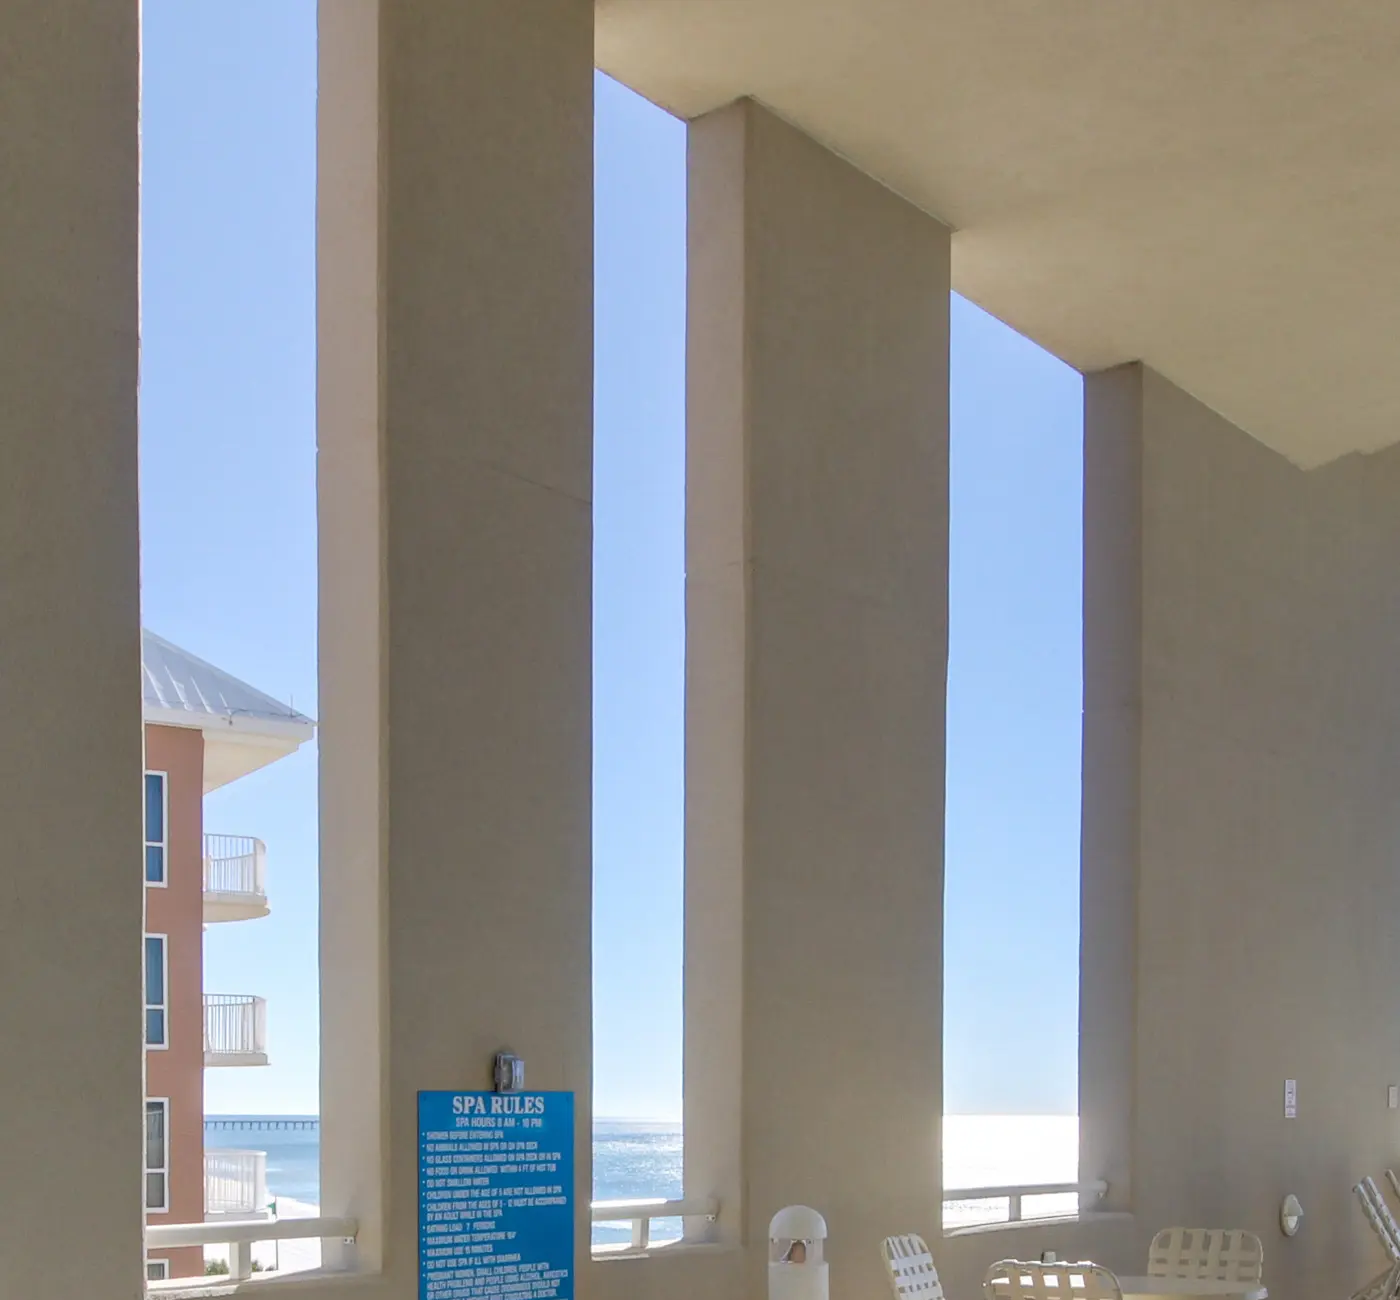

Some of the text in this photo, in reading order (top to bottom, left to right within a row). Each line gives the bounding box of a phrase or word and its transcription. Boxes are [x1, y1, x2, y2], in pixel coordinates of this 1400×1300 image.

[452, 1095, 544, 1114] SPA RULES
[455, 1117, 469, 1126] SPA
[471, 1117, 495, 1127] HOURS
[503, 1117, 515, 1126] AM
